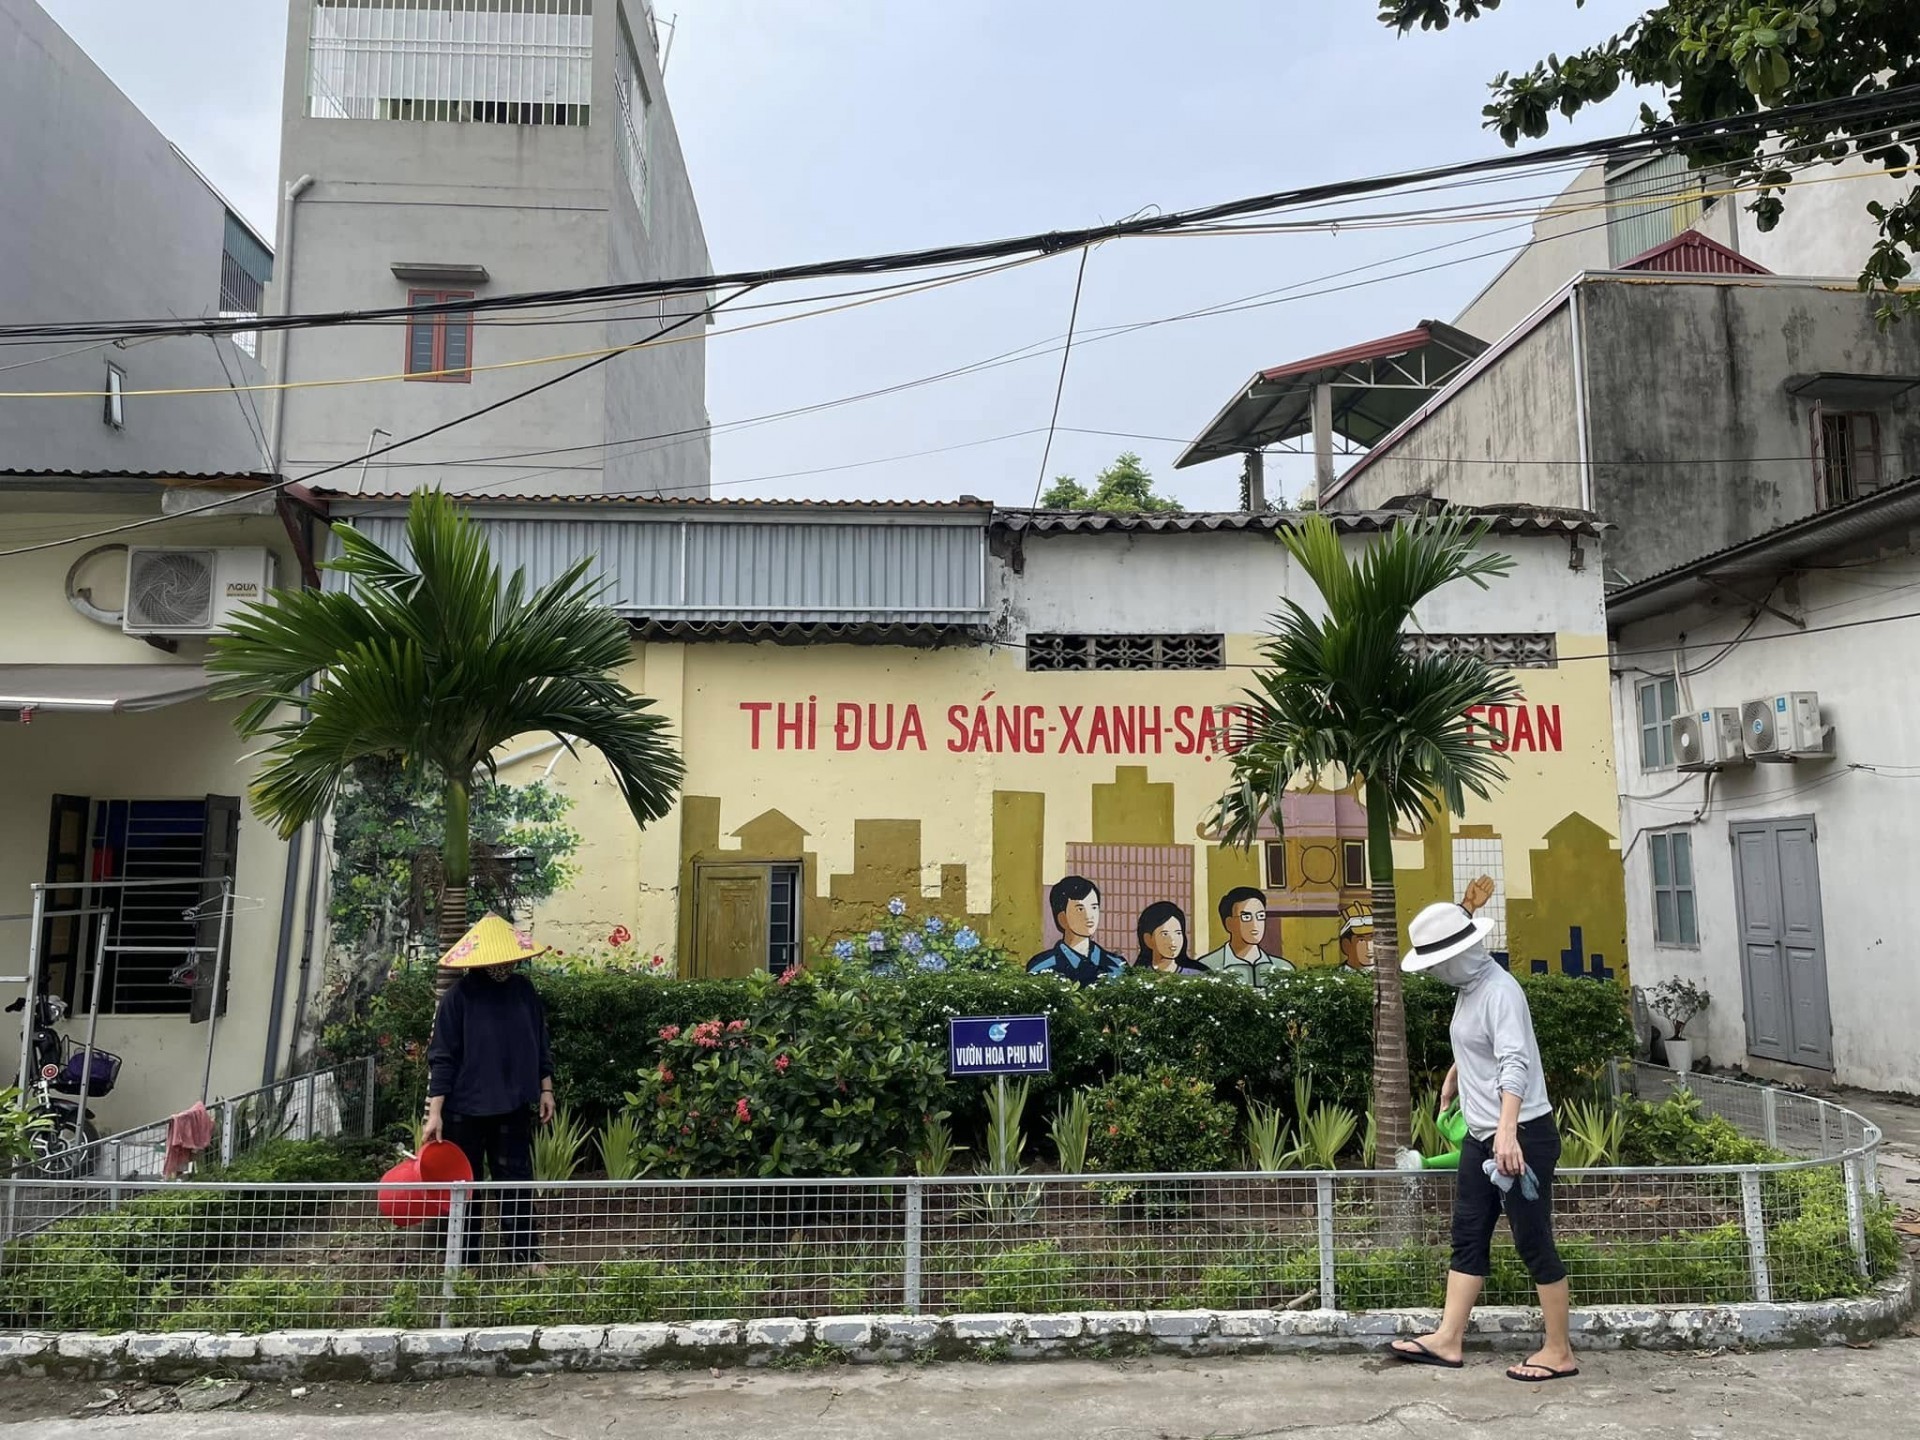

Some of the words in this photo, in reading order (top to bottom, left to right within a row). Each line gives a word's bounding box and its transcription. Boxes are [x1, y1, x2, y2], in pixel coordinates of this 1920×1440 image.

[227, 583, 257, 591] AQUA
[834, 702, 928, 751] ĐUA
[956, 1043, 983, 1066] VƯỜN
[985, 1046, 1005, 1065] HOA
[1007, 1045, 1026, 1068] PHỤ
[1029, 1041, 1044, 1063] NỮ
